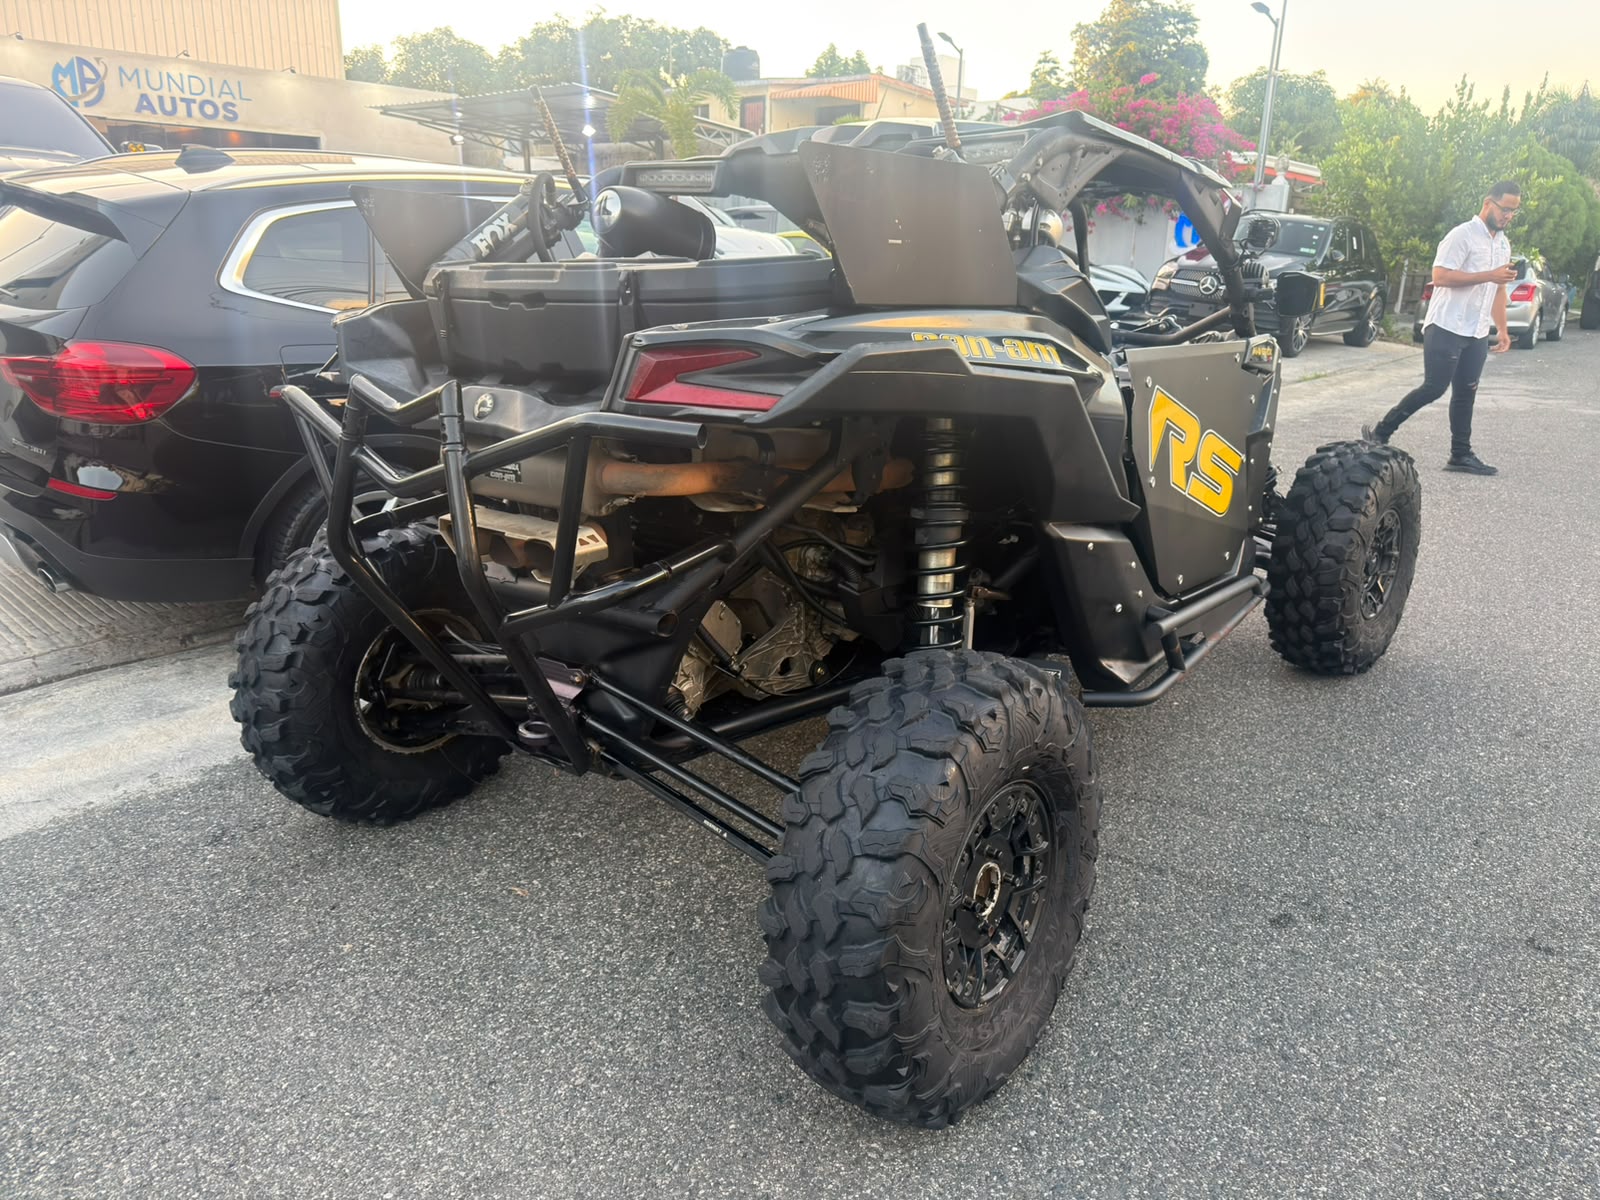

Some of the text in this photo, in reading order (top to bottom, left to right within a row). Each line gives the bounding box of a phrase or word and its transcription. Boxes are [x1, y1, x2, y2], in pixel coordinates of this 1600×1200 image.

[118, 65, 253, 101] MUNDIAL
[135, 93, 239, 122] AUTOS
[470, 212, 518, 257] FOX
[1148, 384, 1246, 518] RS
